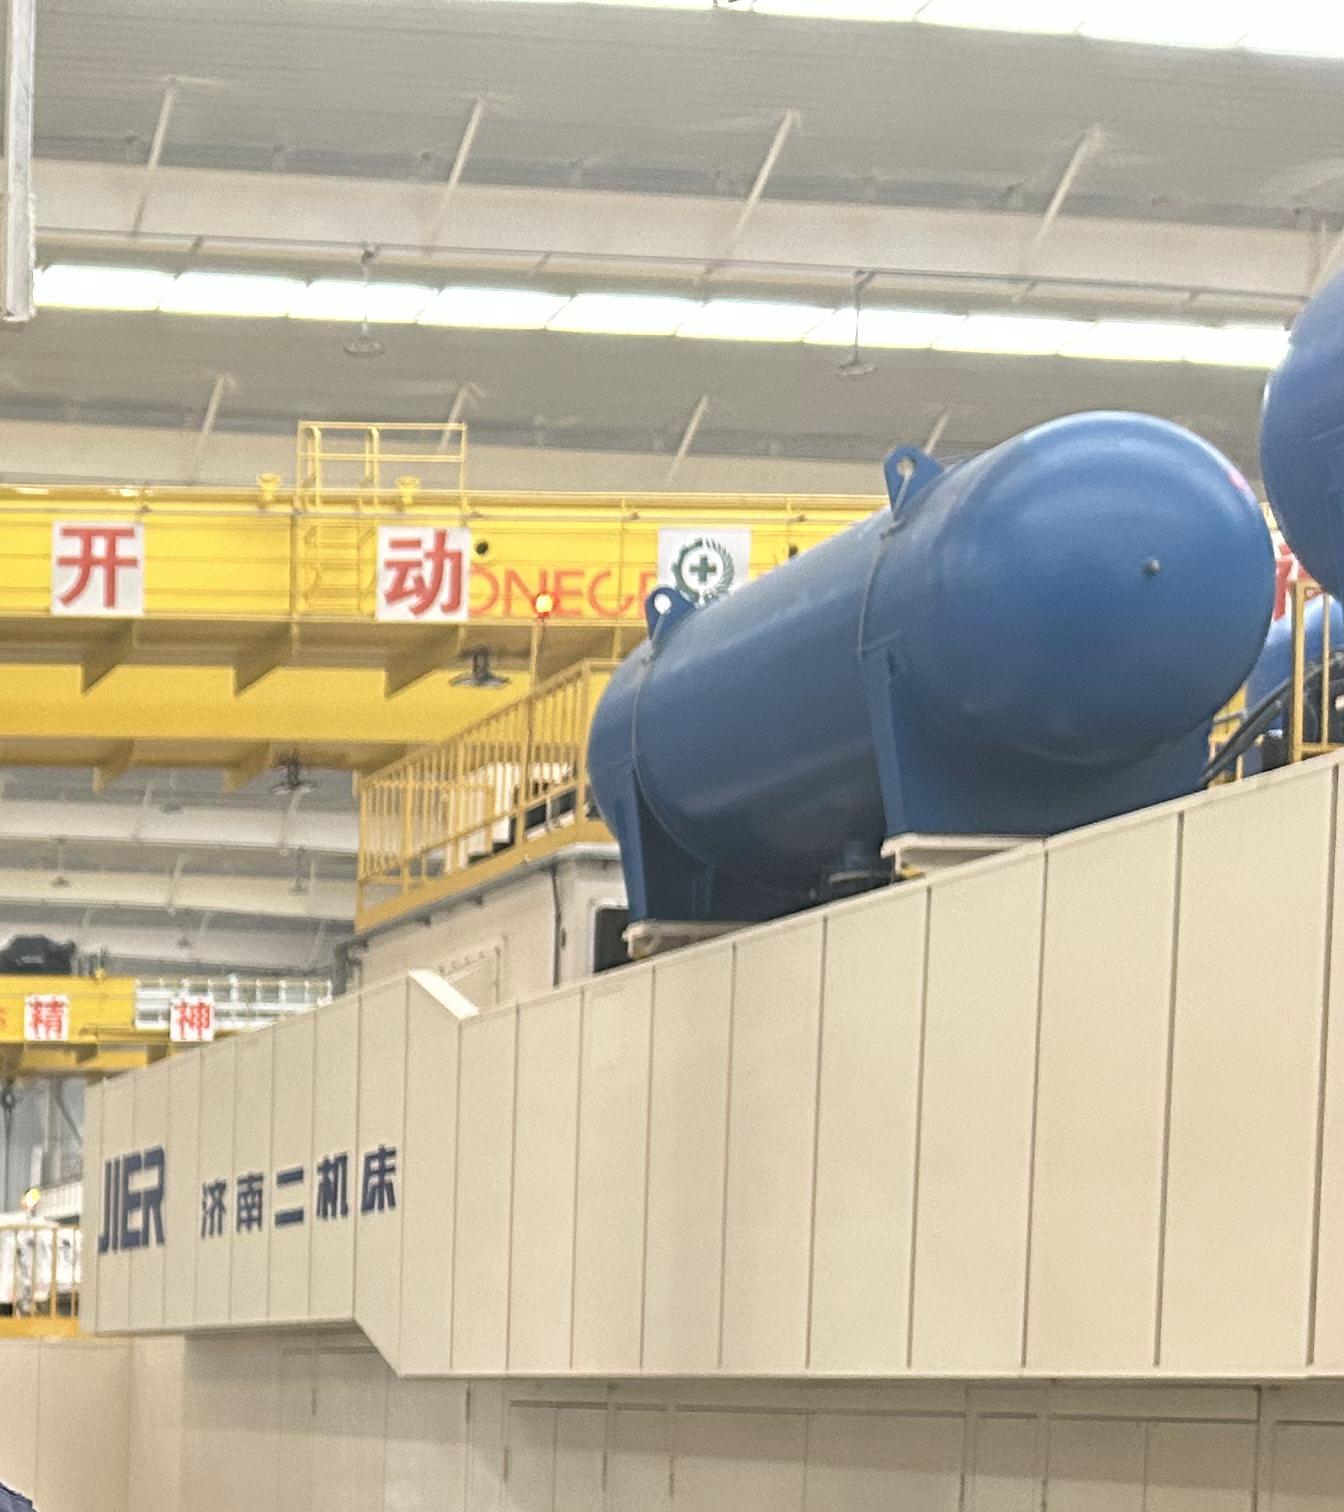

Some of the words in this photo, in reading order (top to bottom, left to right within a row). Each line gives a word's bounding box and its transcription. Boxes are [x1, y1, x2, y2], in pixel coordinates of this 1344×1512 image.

[57, 527, 138, 608] 开
[383, 528, 465, 617] 动
[200, 1144, 397, 1239] 济南二机床
